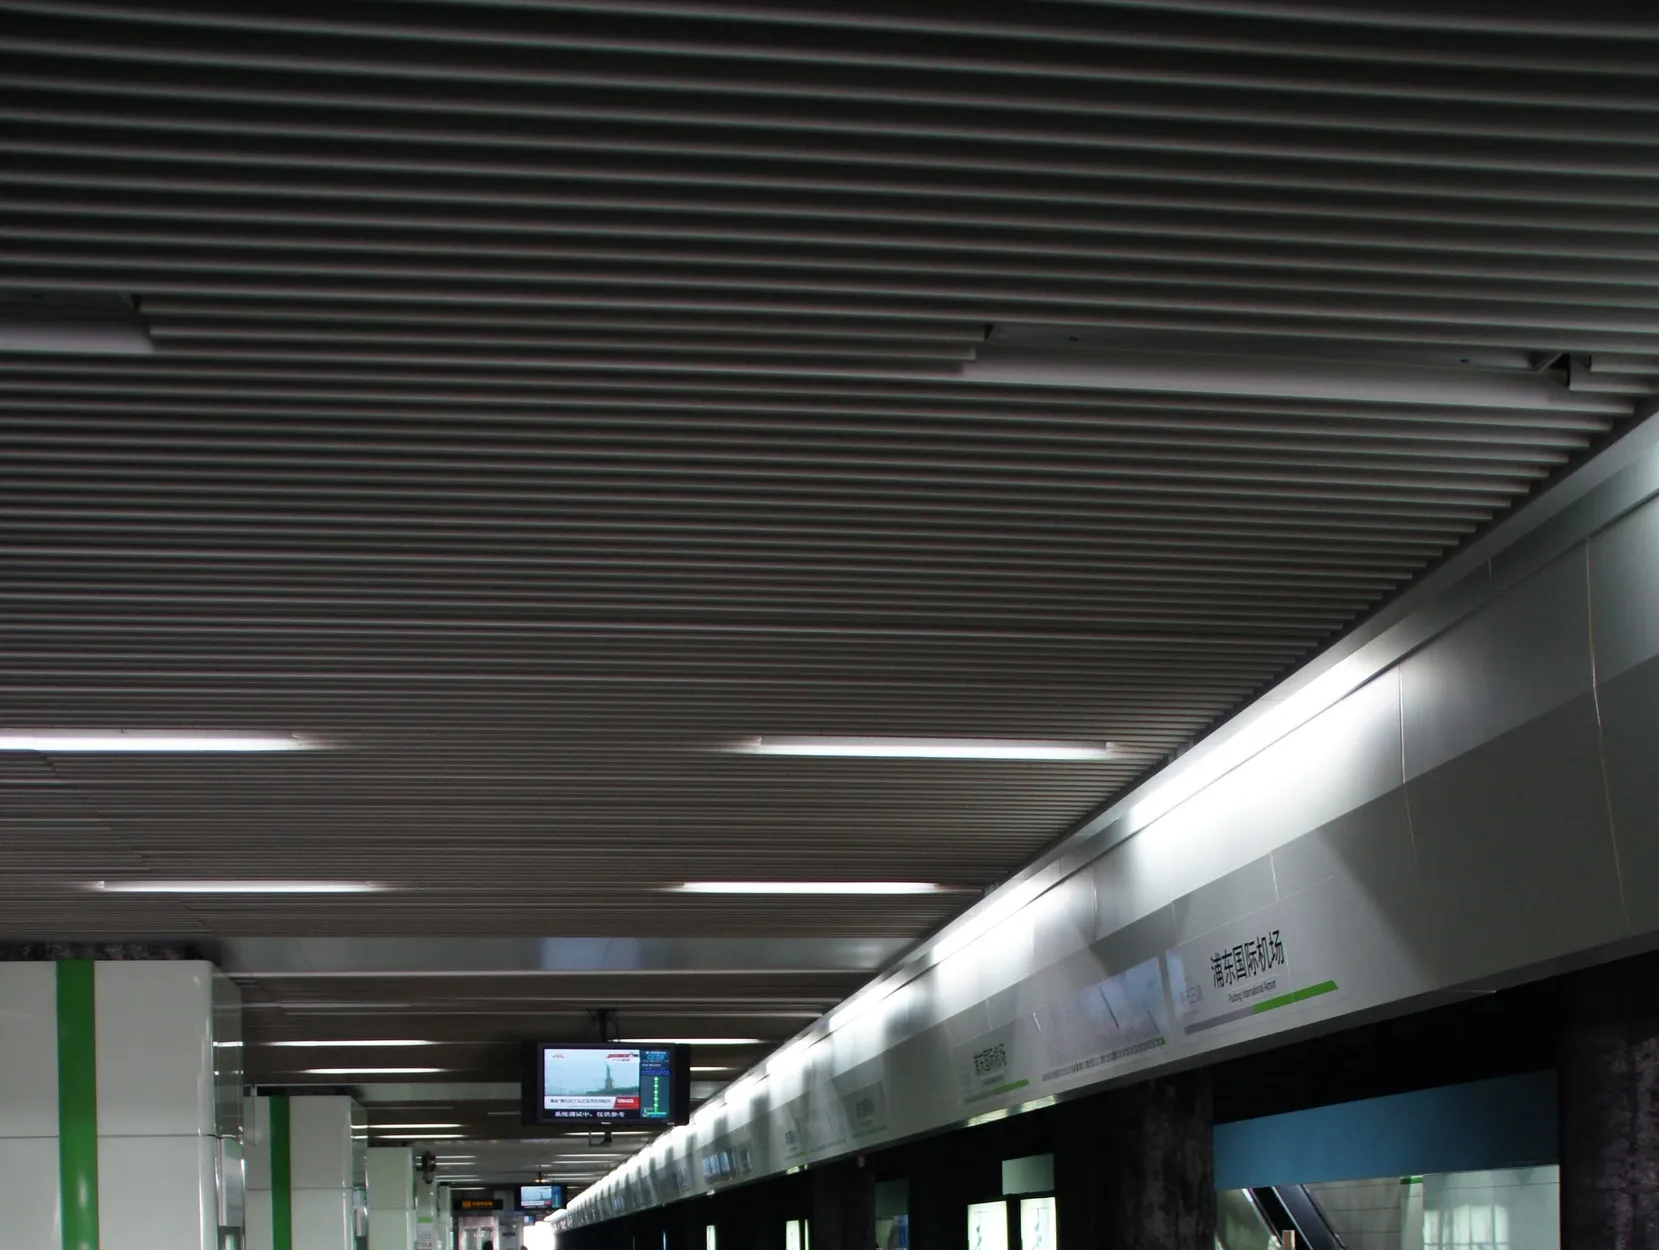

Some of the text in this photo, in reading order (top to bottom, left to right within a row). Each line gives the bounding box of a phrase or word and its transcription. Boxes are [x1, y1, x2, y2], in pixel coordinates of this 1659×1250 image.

[1210, 930, 1285, 988] 浦东国际机场
